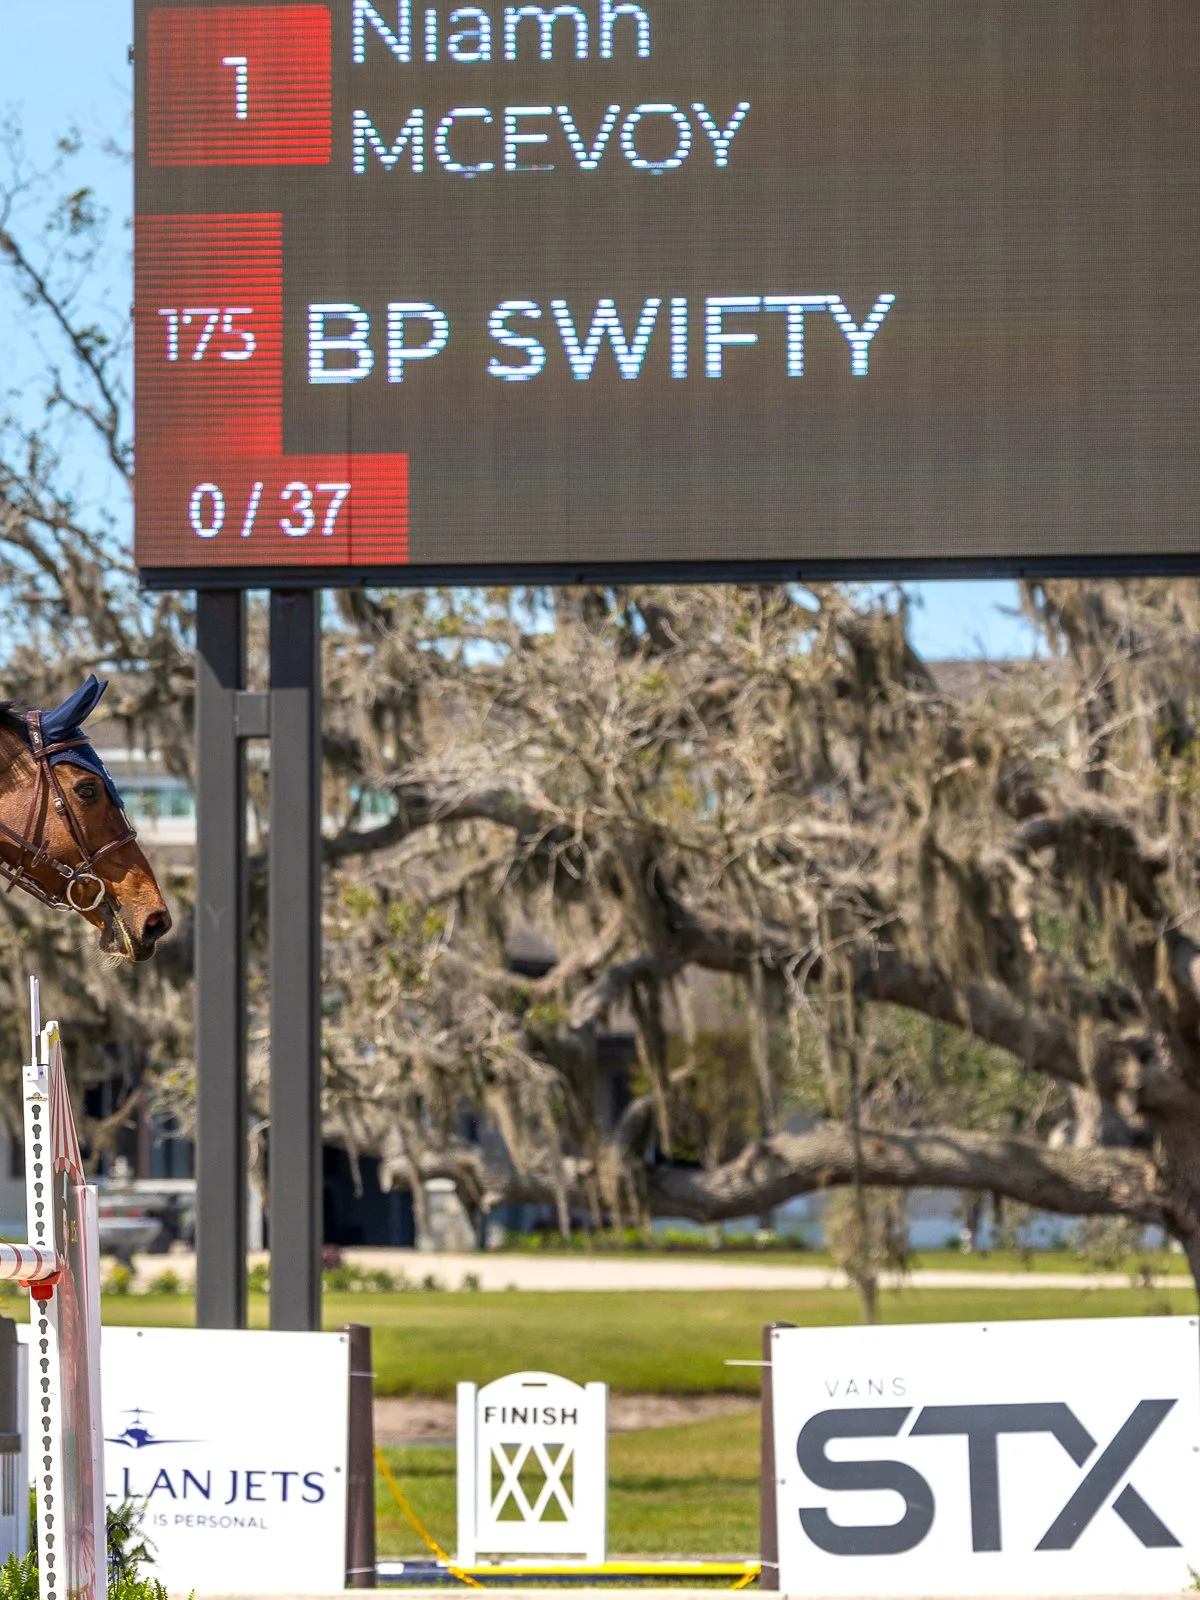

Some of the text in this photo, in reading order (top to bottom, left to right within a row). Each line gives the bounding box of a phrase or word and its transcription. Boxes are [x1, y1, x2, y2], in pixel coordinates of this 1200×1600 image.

[352, 0, 650, 63] Niamh
[222, 56, 248, 120] 1
[352, 101, 751, 177] MCEVOY
[158, 306, 257, 361] 175
[307, 293, 896, 384] BP SWIFTY
[188, 481, 352, 538] 0 / 37
[484, 1406, 578, 1425] FINISH
[824, 1377, 907, 1398] VANS
[224, 1469, 326, 1506] JETS
[796, 1398, 1183, 1556] STX
[153, 1513, 168, 1527] IS
[174, 1514, 269, 1530] PERSONAL
